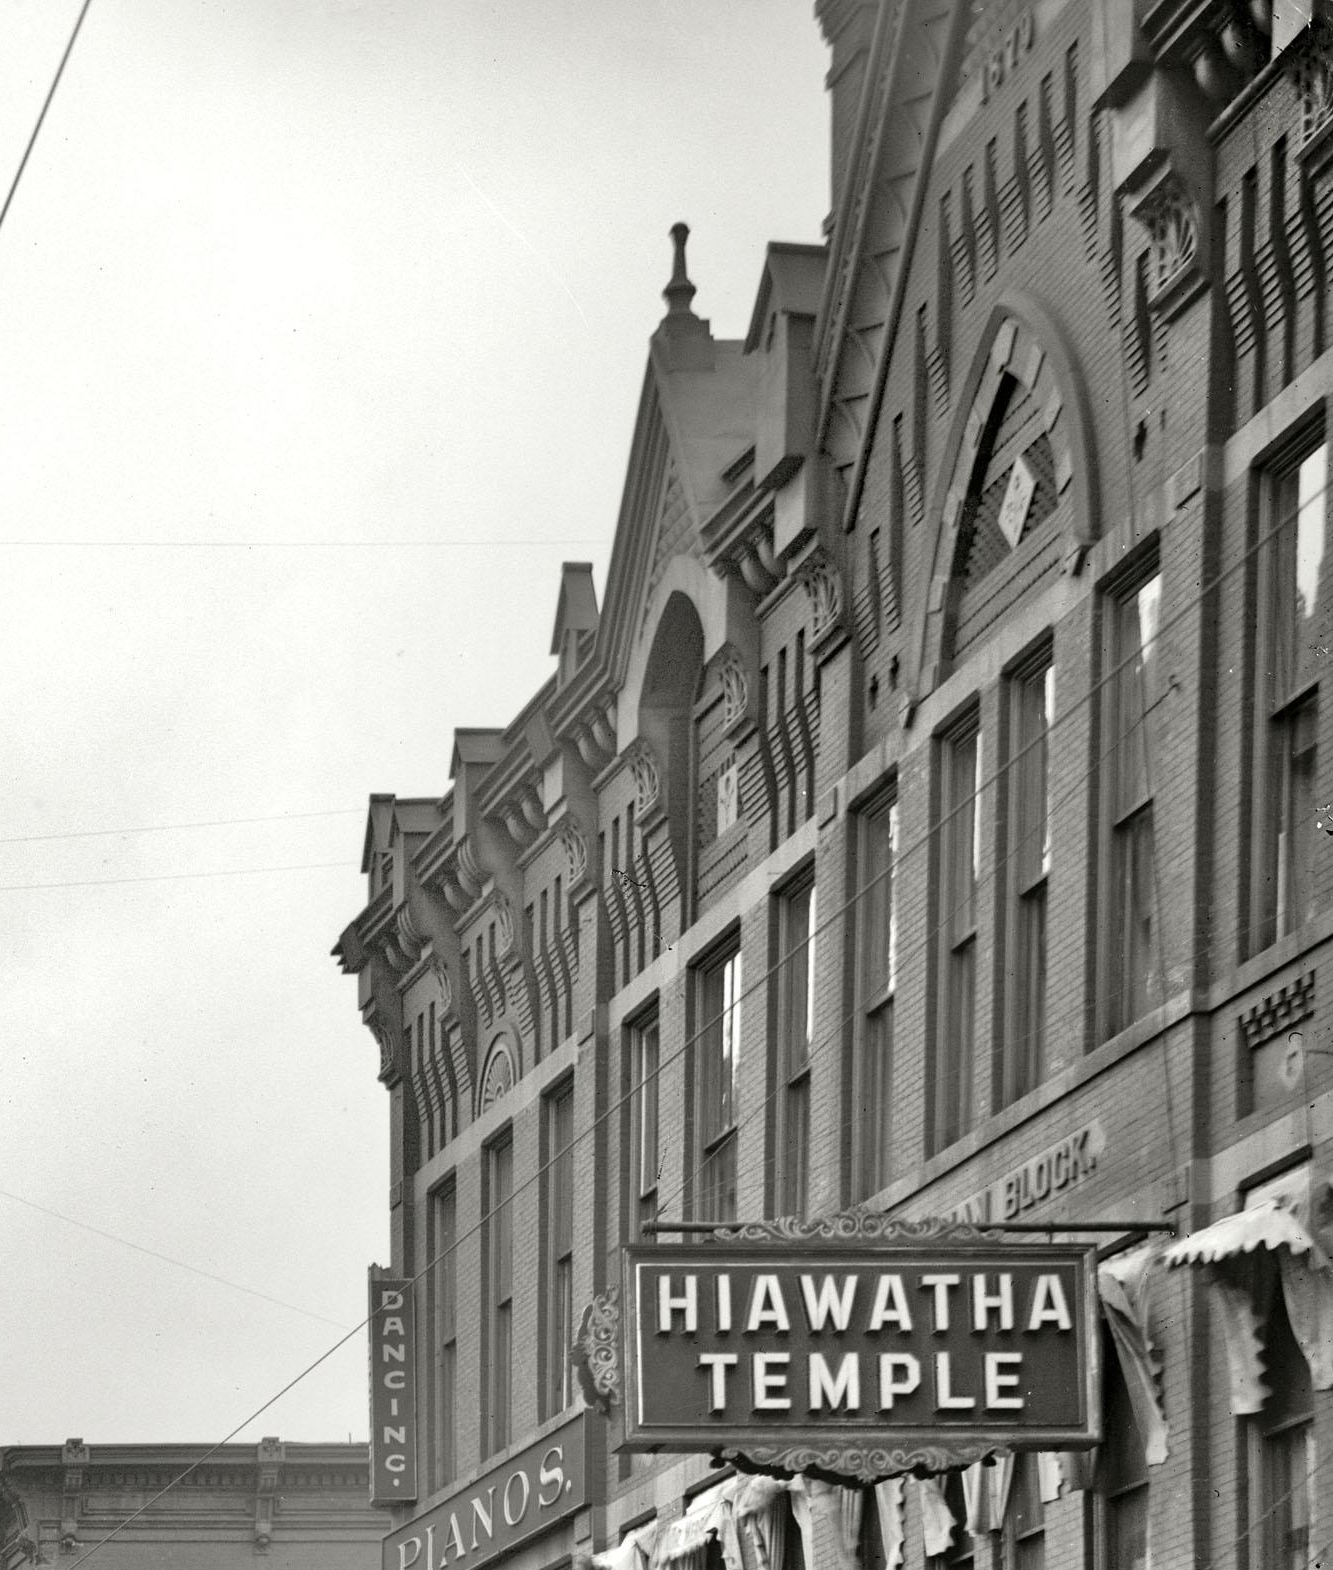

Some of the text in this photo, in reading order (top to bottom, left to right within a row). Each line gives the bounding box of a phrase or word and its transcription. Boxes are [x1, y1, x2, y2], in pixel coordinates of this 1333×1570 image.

[1004, 1130, 1097, 1220] BLOCK.
[655, 1272, 1073, 1334] HIAWATHA
[697, 1352, 1025, 1413] TEMPLE
